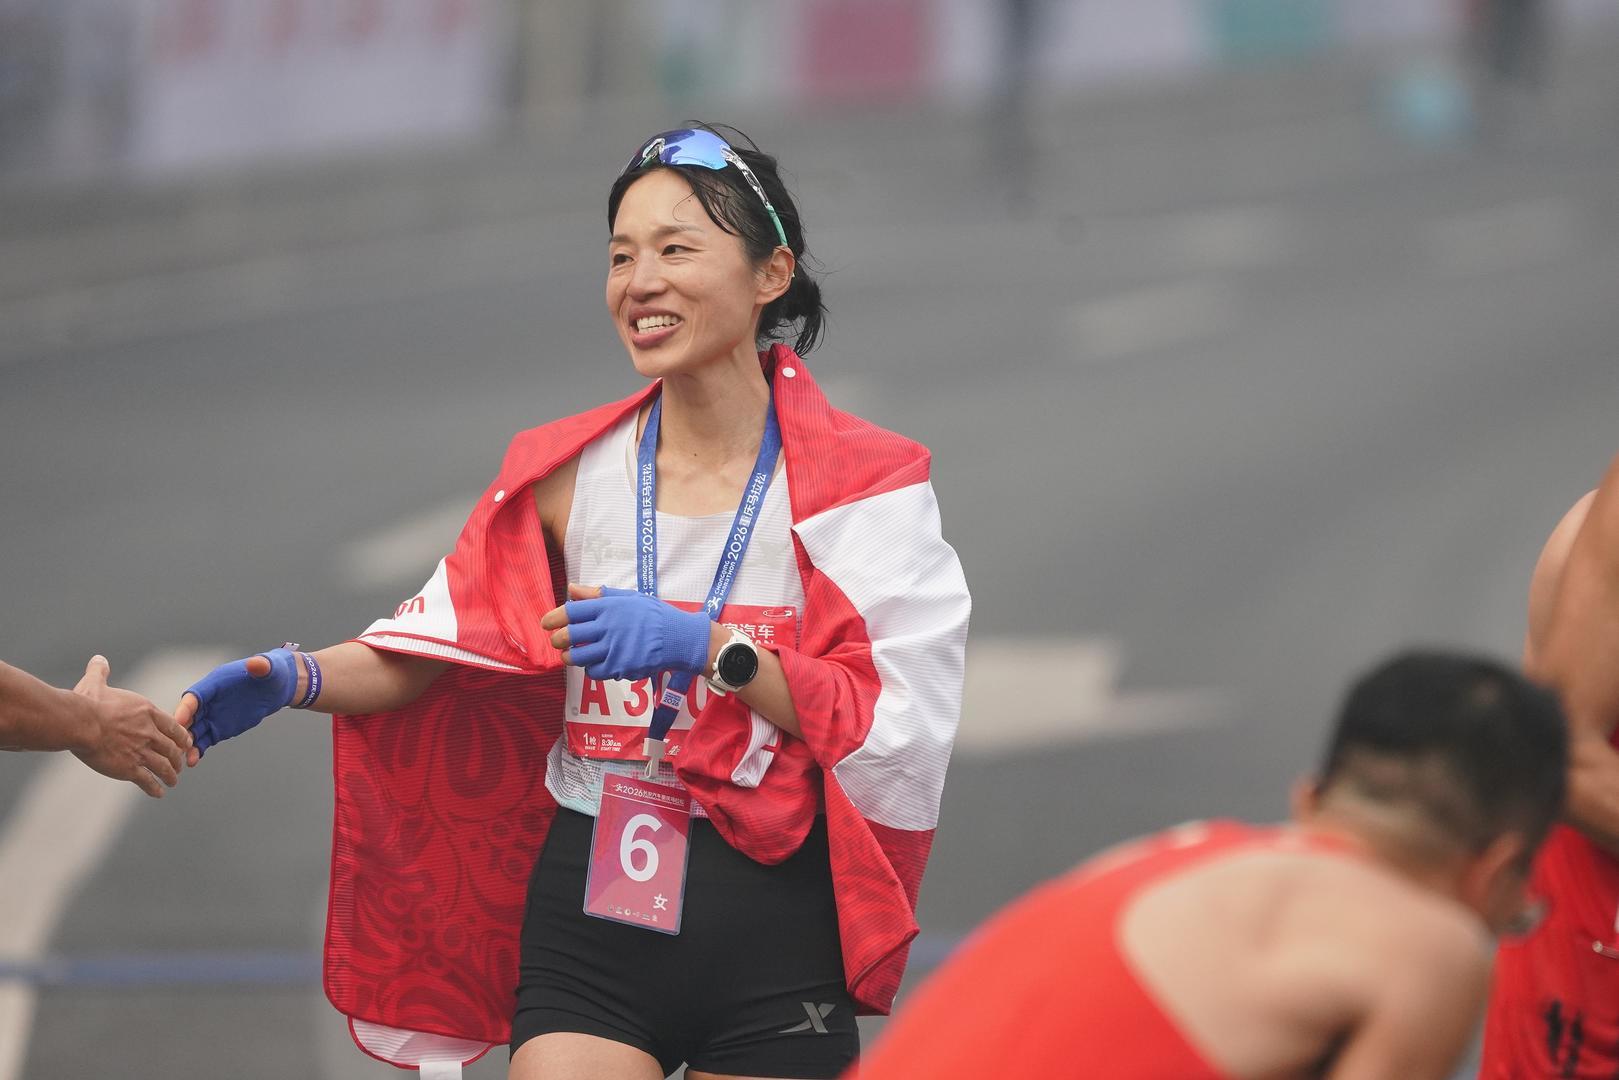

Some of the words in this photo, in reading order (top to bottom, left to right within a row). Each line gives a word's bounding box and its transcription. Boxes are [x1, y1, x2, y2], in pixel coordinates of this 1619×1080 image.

[642, 463, 653, 553] 2026重庆马拉松
[728, 472, 767, 561] 2026重庆马拉松
[619, 813, 662, 882] 6
[653, 893, 668, 911] 女
